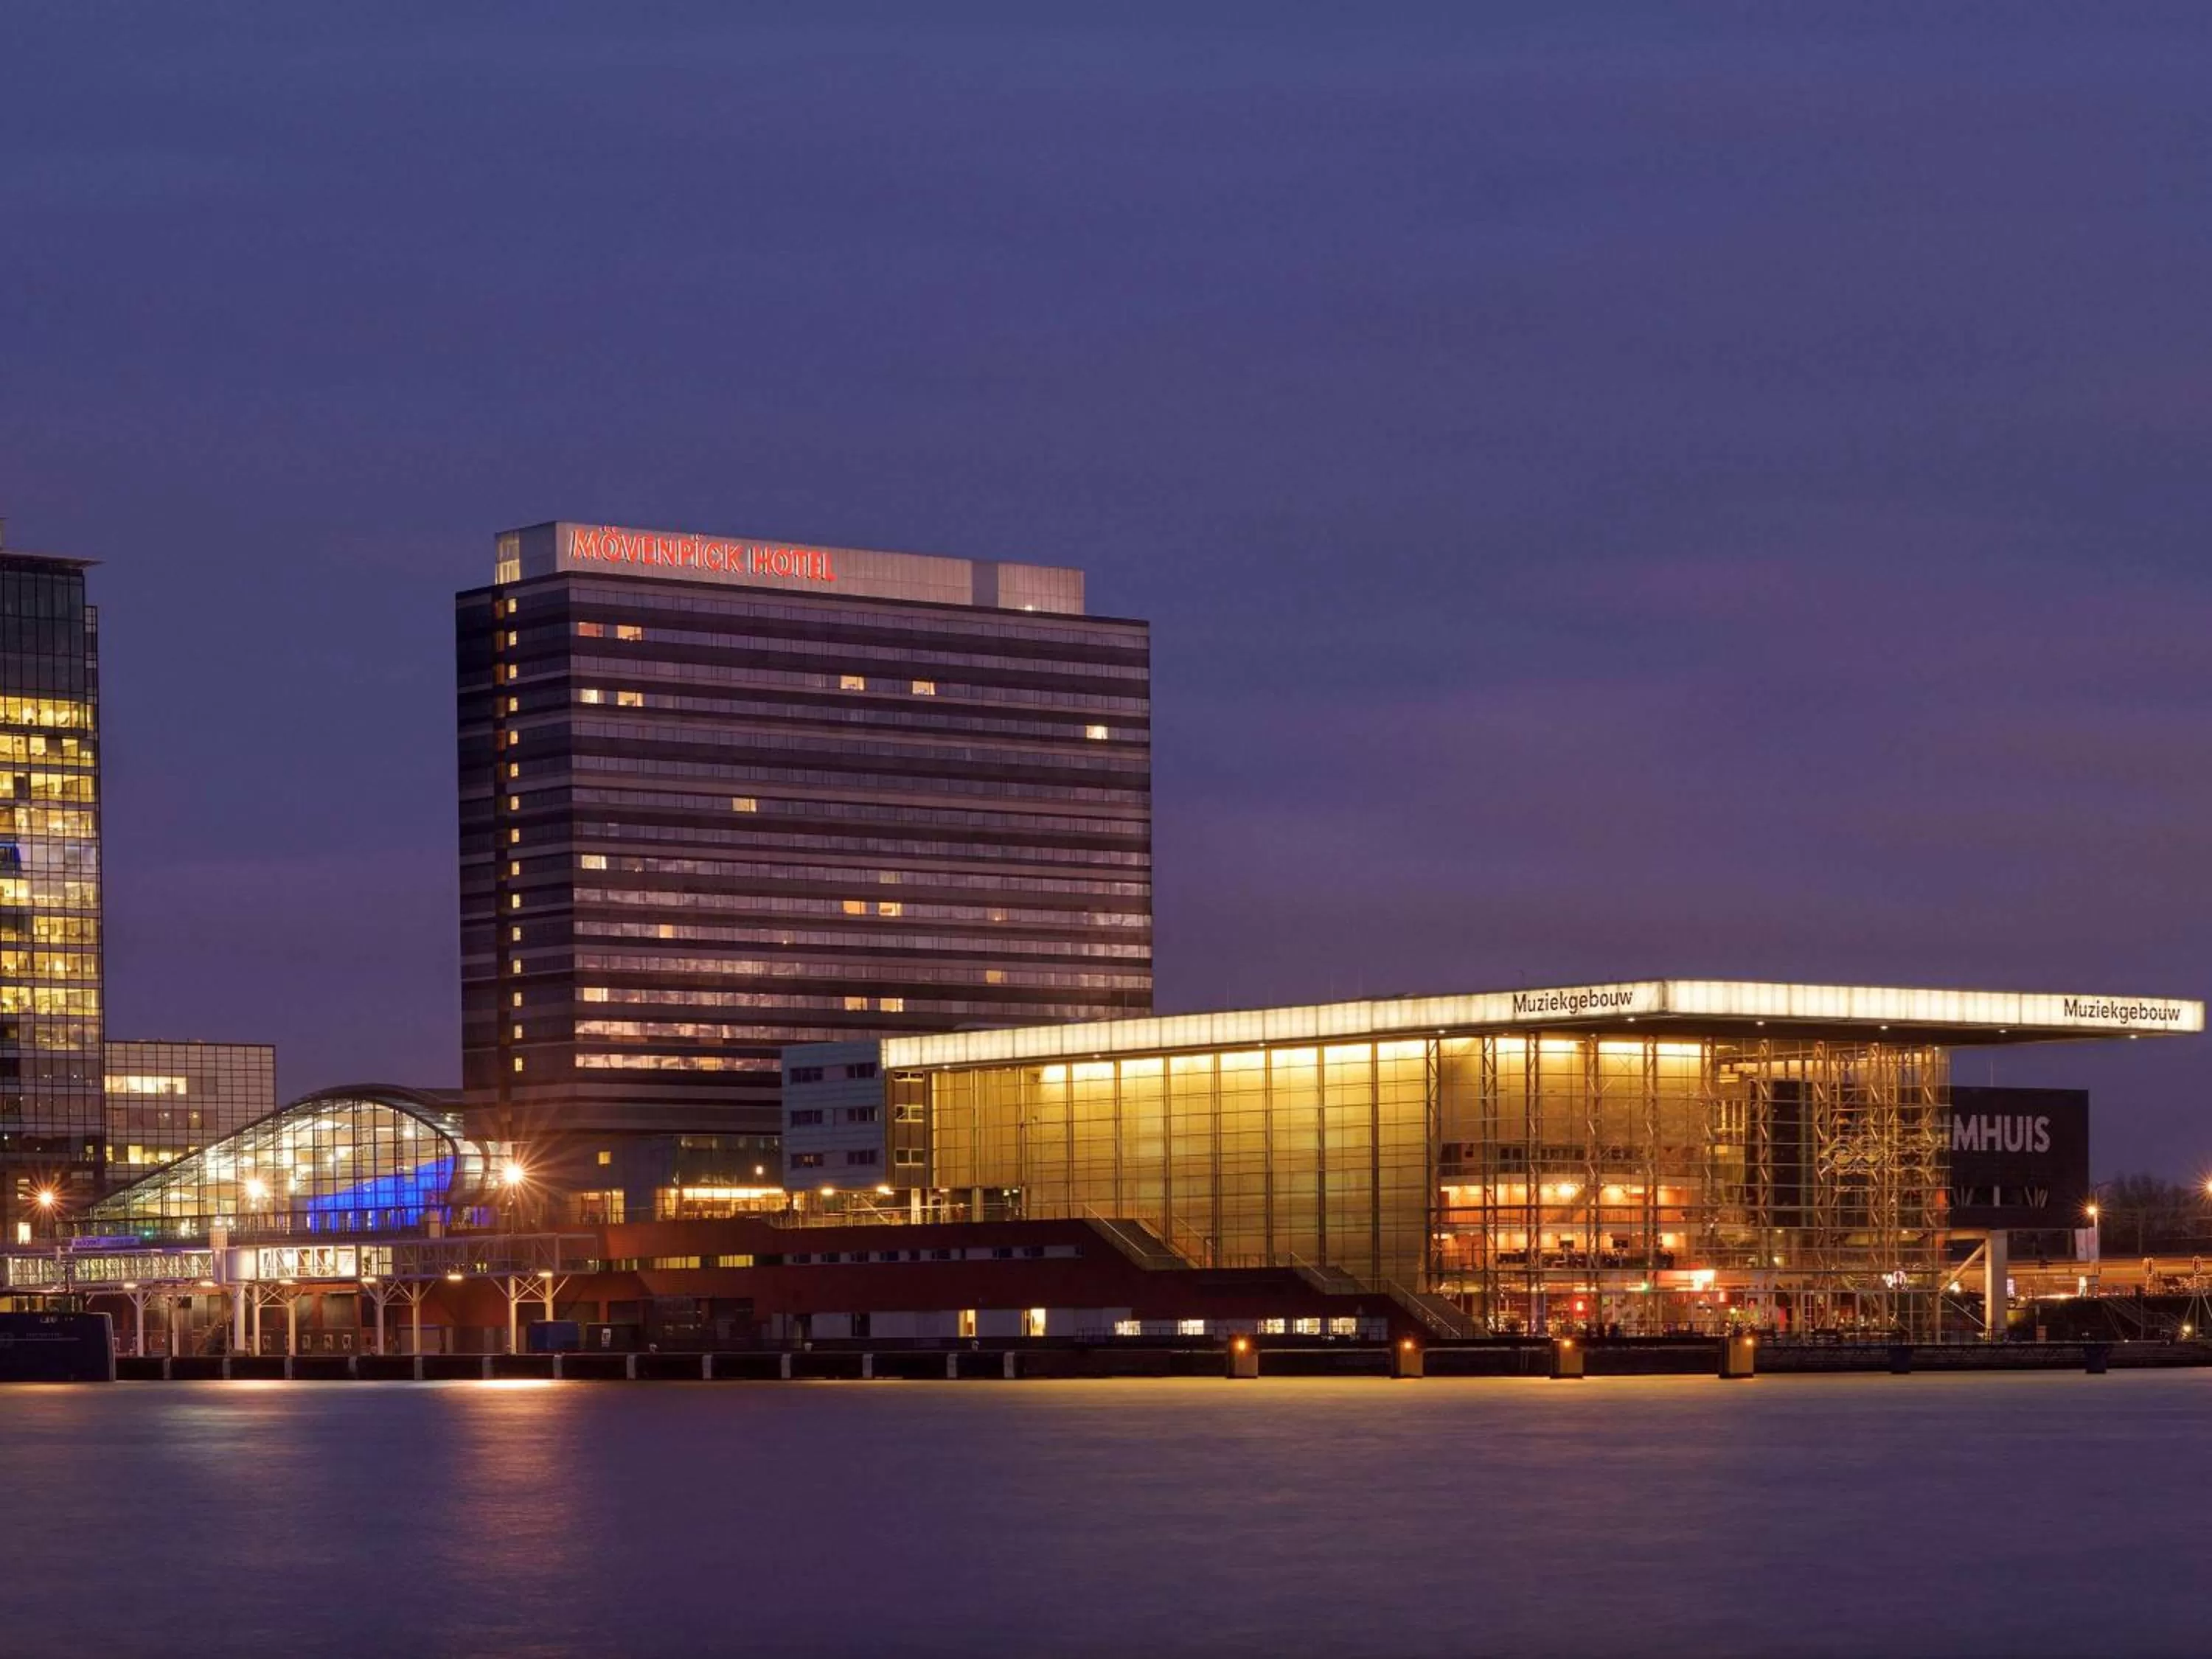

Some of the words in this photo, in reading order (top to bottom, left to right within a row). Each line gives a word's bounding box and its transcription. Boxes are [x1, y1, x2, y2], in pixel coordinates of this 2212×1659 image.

[748, 546, 836, 582] HOTEL
[1513, 989, 1633, 1014] Muziekgebouw
[2065, 998, 2180, 1024] Muziekgebouw
[1935, 1113, 2051, 1152] MHUIS
